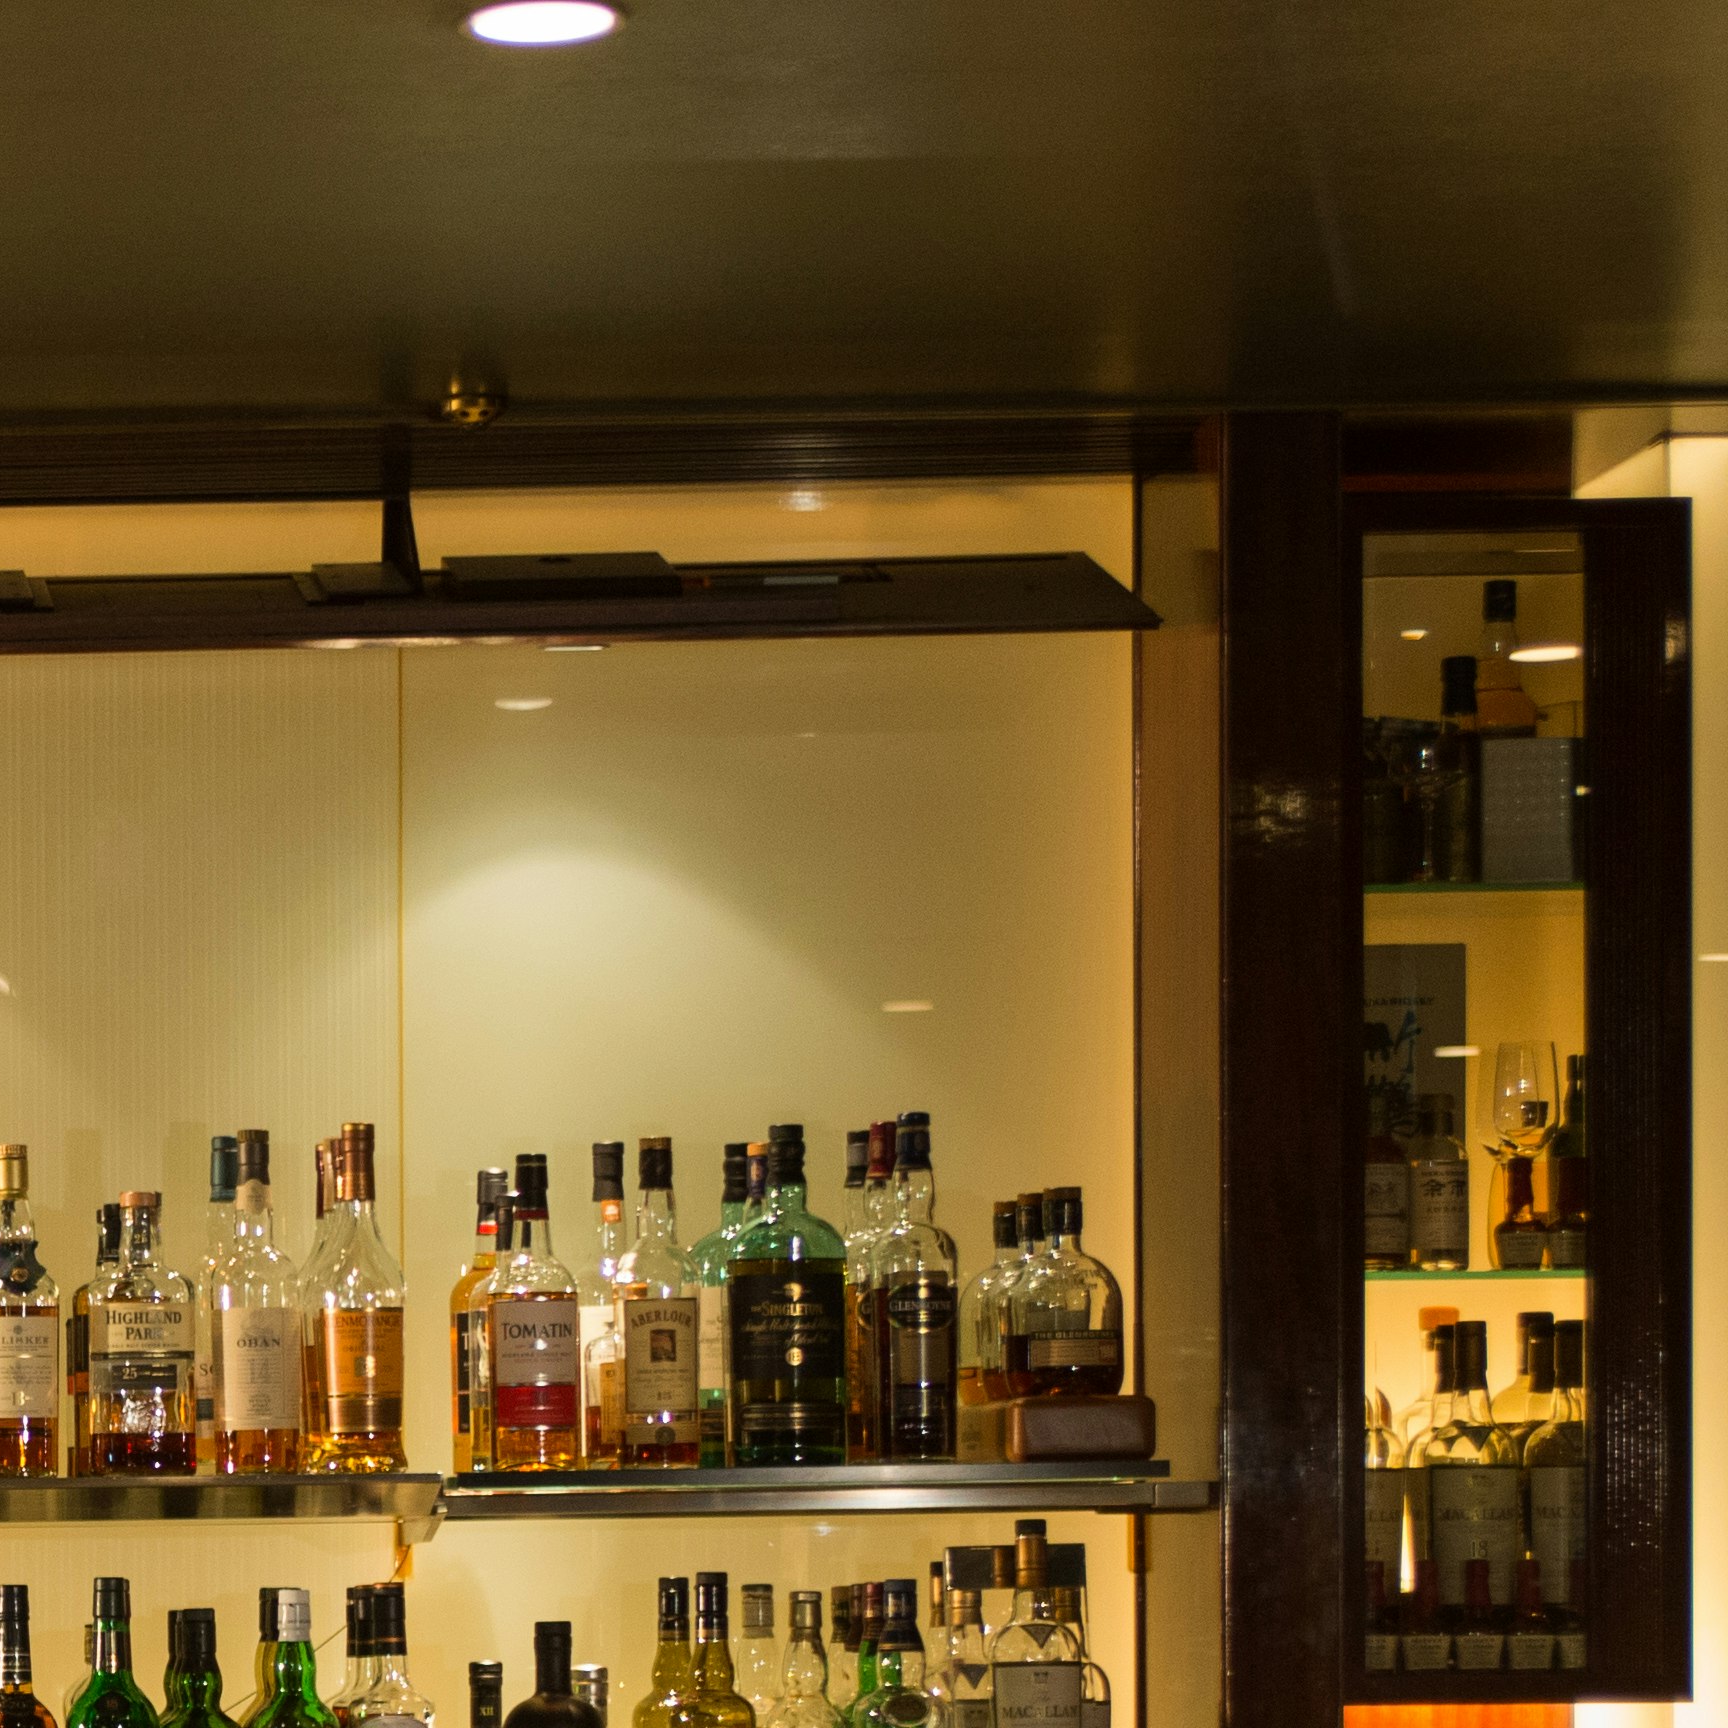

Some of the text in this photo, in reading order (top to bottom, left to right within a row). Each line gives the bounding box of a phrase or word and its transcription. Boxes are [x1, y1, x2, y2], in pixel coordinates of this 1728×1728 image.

[106, 1309, 183, 1325] HIGHLAND
[630, 1308, 692, 1330] ABERLOUR
[126, 1326, 166, 1341] PARK
[501, 1321, 573, 1341] TOMATIN
[236, 1338, 281, 1349] OBAN
[122, 1366, 138, 1380] 25
[479, 1705, 494, 1716] XII
